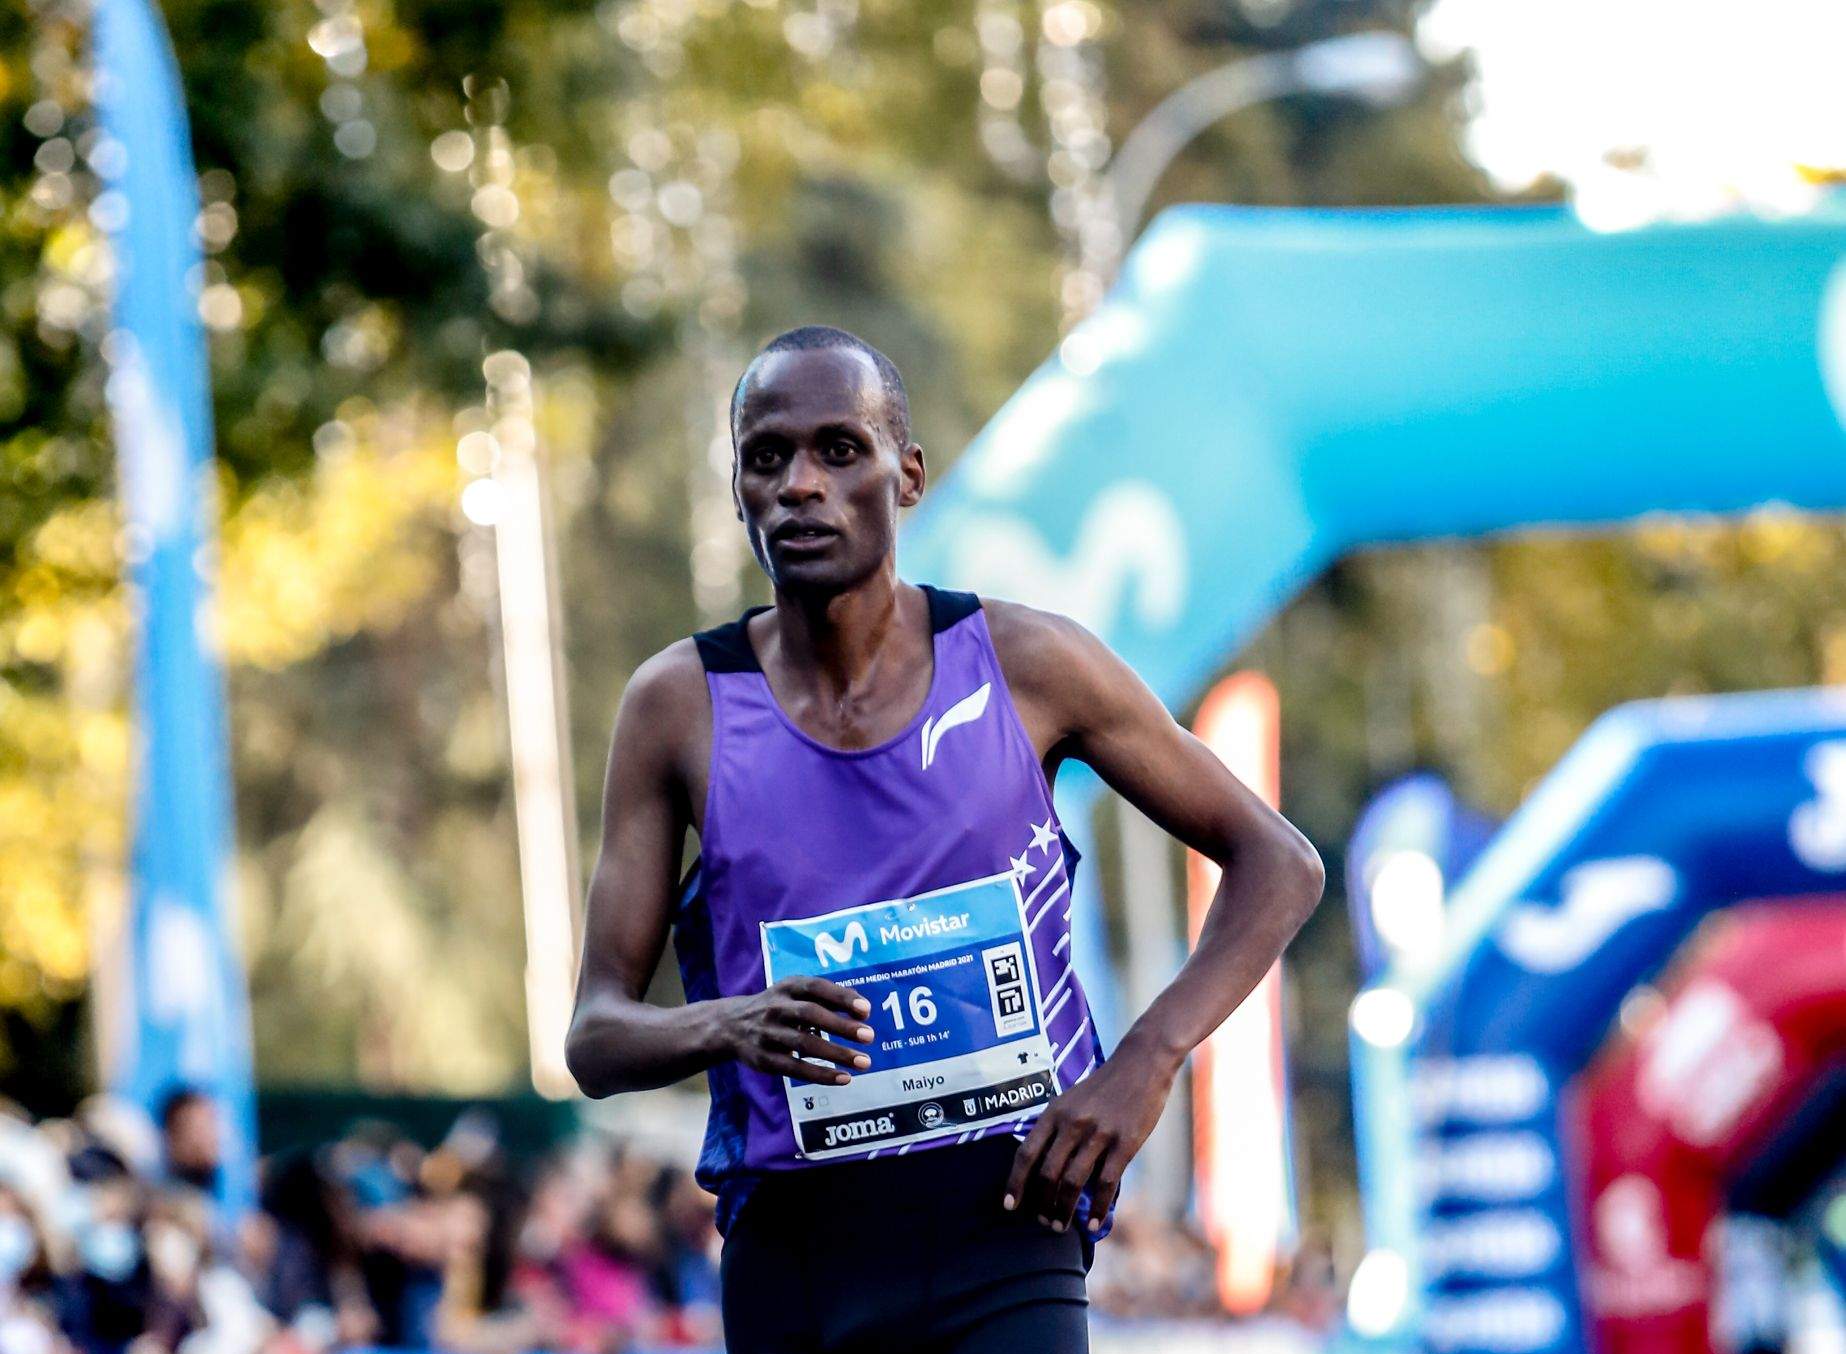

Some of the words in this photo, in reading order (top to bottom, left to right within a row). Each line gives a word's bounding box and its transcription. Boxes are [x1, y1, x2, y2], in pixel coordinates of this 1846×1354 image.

[880, 912, 969, 945] Movistar
[866, 972, 891, 984] MEDIO
[891, 965, 928, 979] MARATÓN
[928, 958, 957, 971] MADRID
[957, 954, 974, 965] 2021
[881, 985, 938, 1031] 16
[881, 1040, 904, 1051] ÉLITE
[908, 1035, 926, 1047] SUB
[926, 1033, 938, 1043] 1h
[902, 1075, 945, 1092] Maiyo
[985, 1082, 1045, 1110] MADRID
